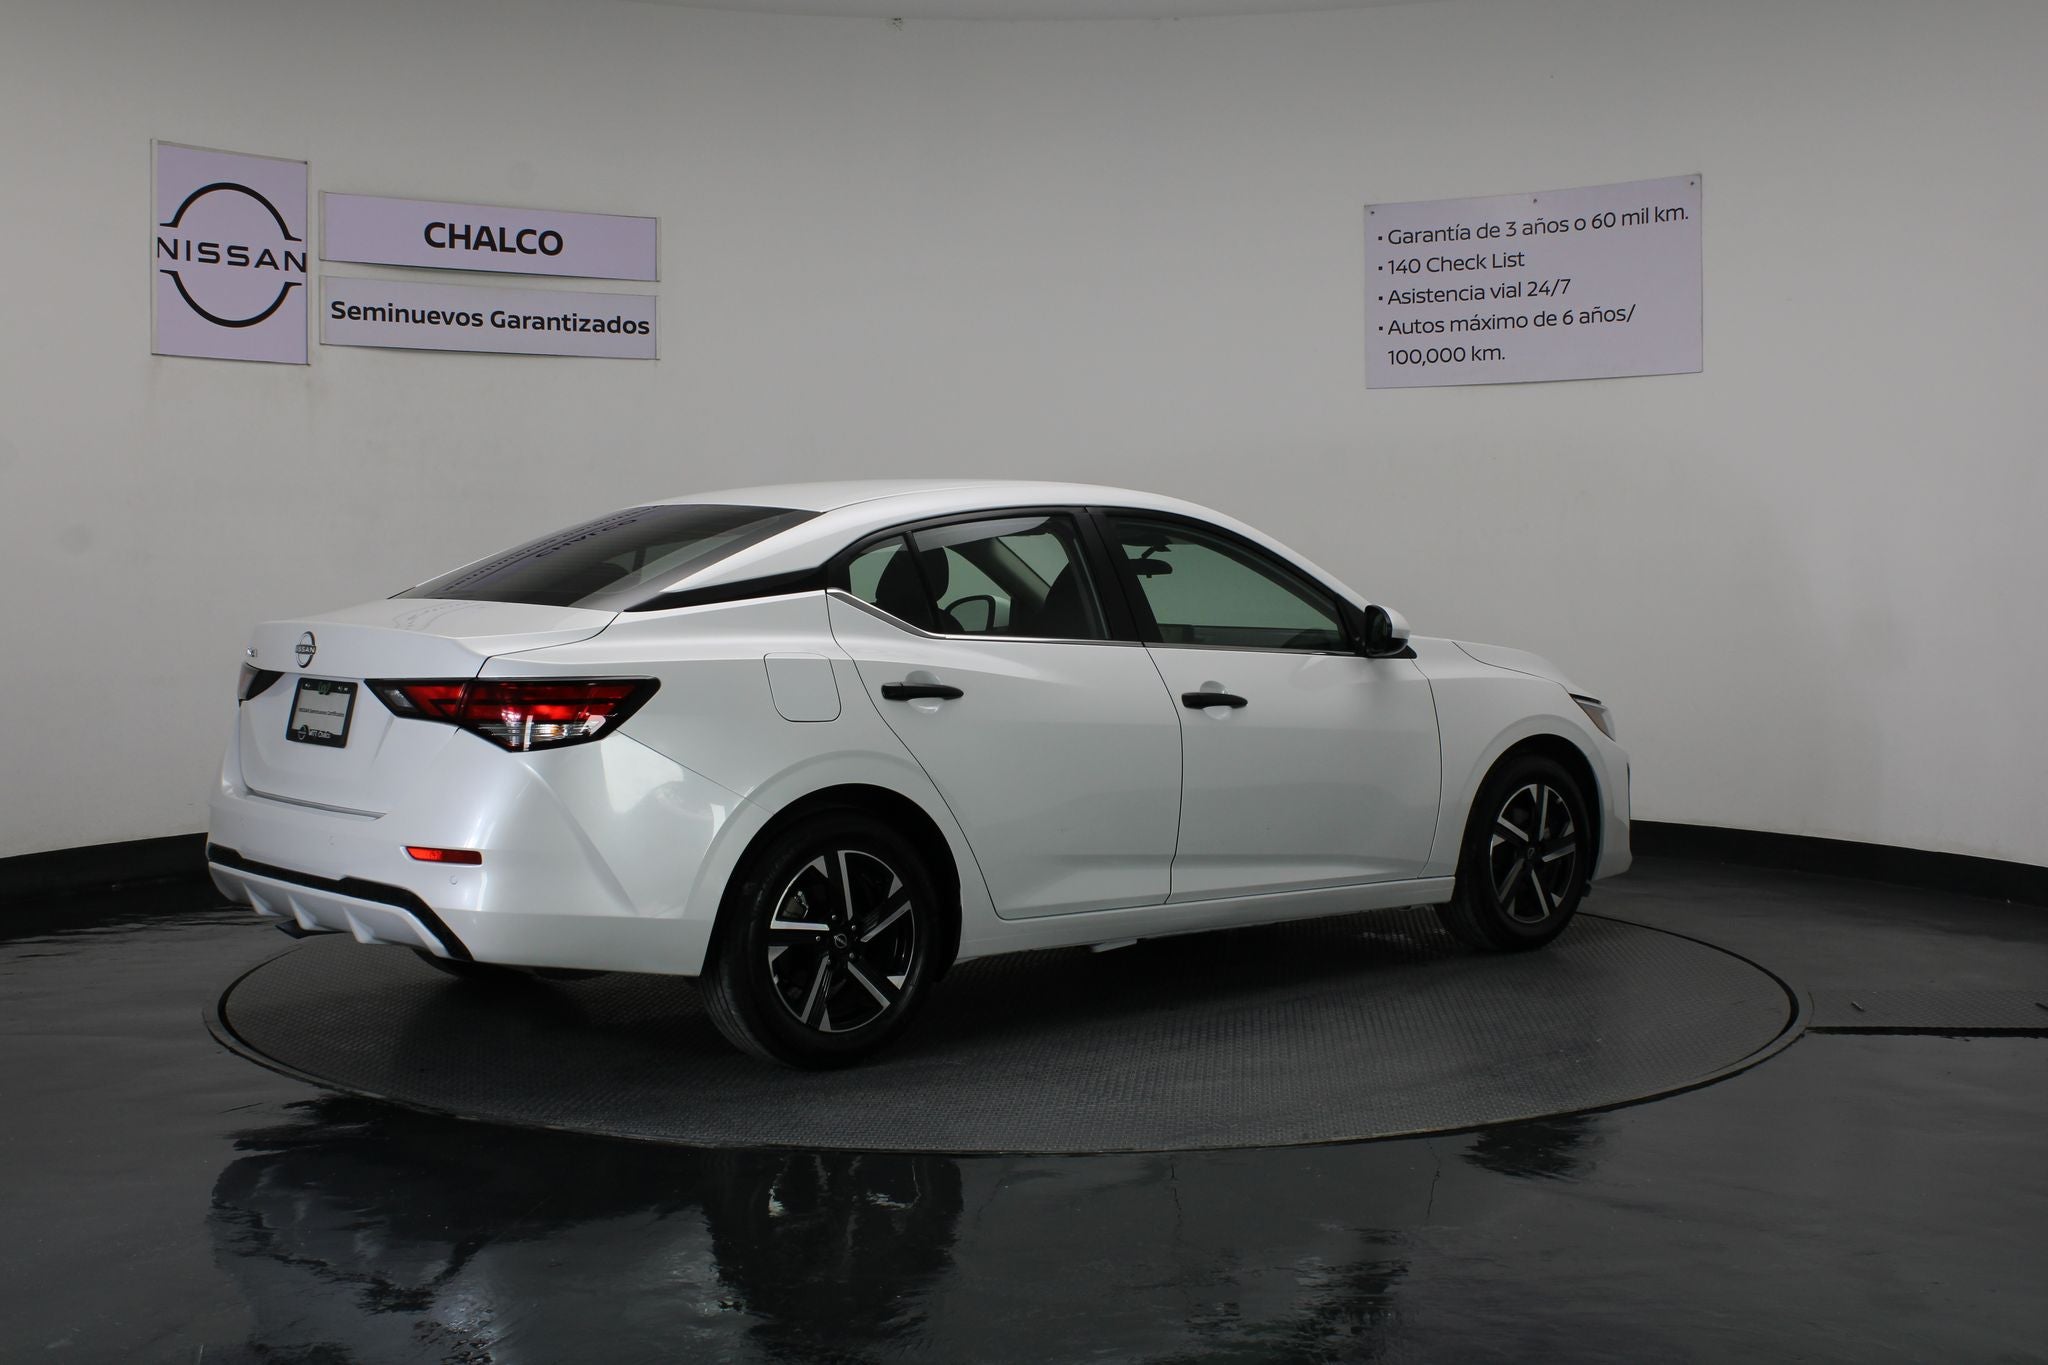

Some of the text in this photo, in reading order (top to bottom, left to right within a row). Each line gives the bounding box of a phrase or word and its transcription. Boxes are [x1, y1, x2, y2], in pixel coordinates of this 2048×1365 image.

[424, 222, 563, 256] CHALCO
[1388, 206, 1688, 244] Garantía de 3 años o 60 mil km.
[157, 237, 306, 272] NISSAN
[1388, 252, 1525, 274] 140 Check List
[1388, 279, 1571, 305] Asistencia vial 24/7
[331, 301, 649, 335] Seminuevos Garantizados
[1388, 304, 1636, 335] Autos máximo de 6 años/
[1388, 345, 1505, 366] 100,000 km.
